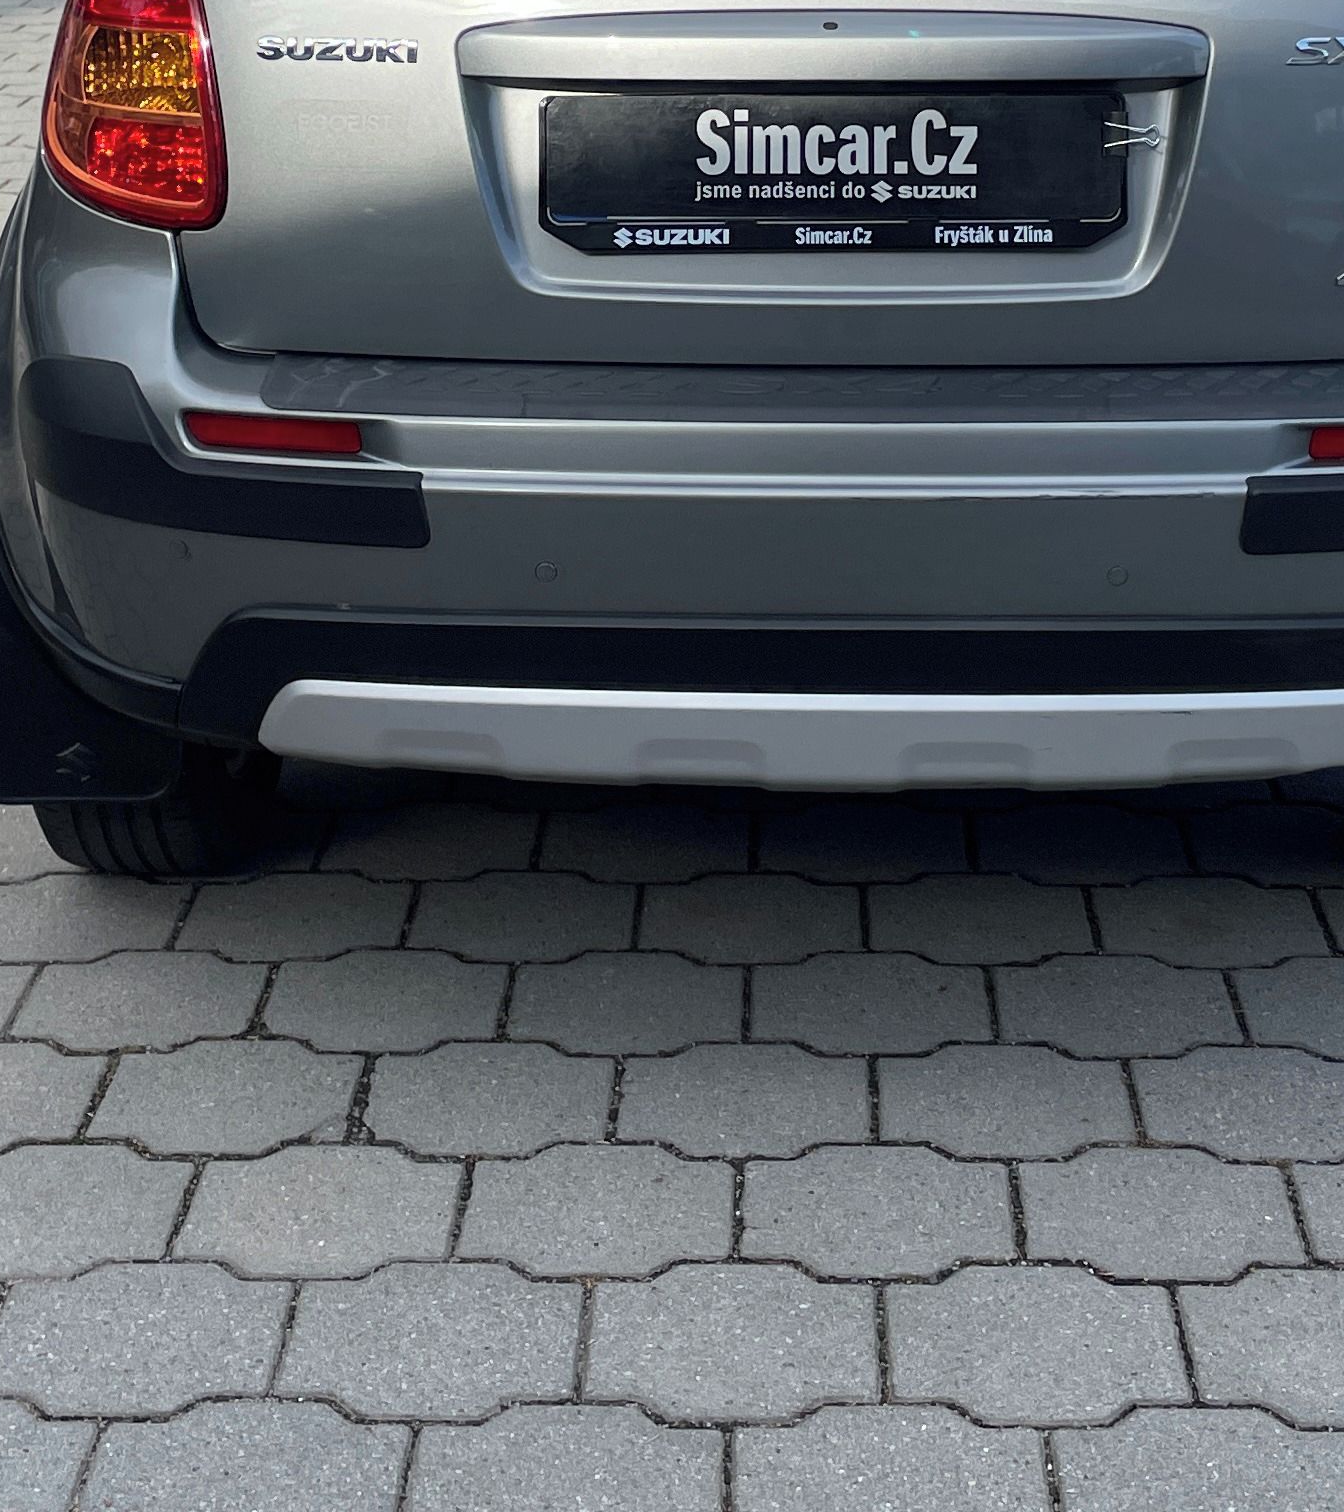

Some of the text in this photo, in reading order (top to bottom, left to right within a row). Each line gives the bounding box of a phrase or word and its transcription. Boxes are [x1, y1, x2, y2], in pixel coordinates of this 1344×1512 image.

[256, 35, 418, 64] SUZUKI
[695, 109, 979, 176] Simcar.Cz
[694, 180, 977, 202] jsme nadšenci do SUZUKI
[635, 224, 1054, 248] SUZUKI Simcar.Cz Fryšták u Zlína
